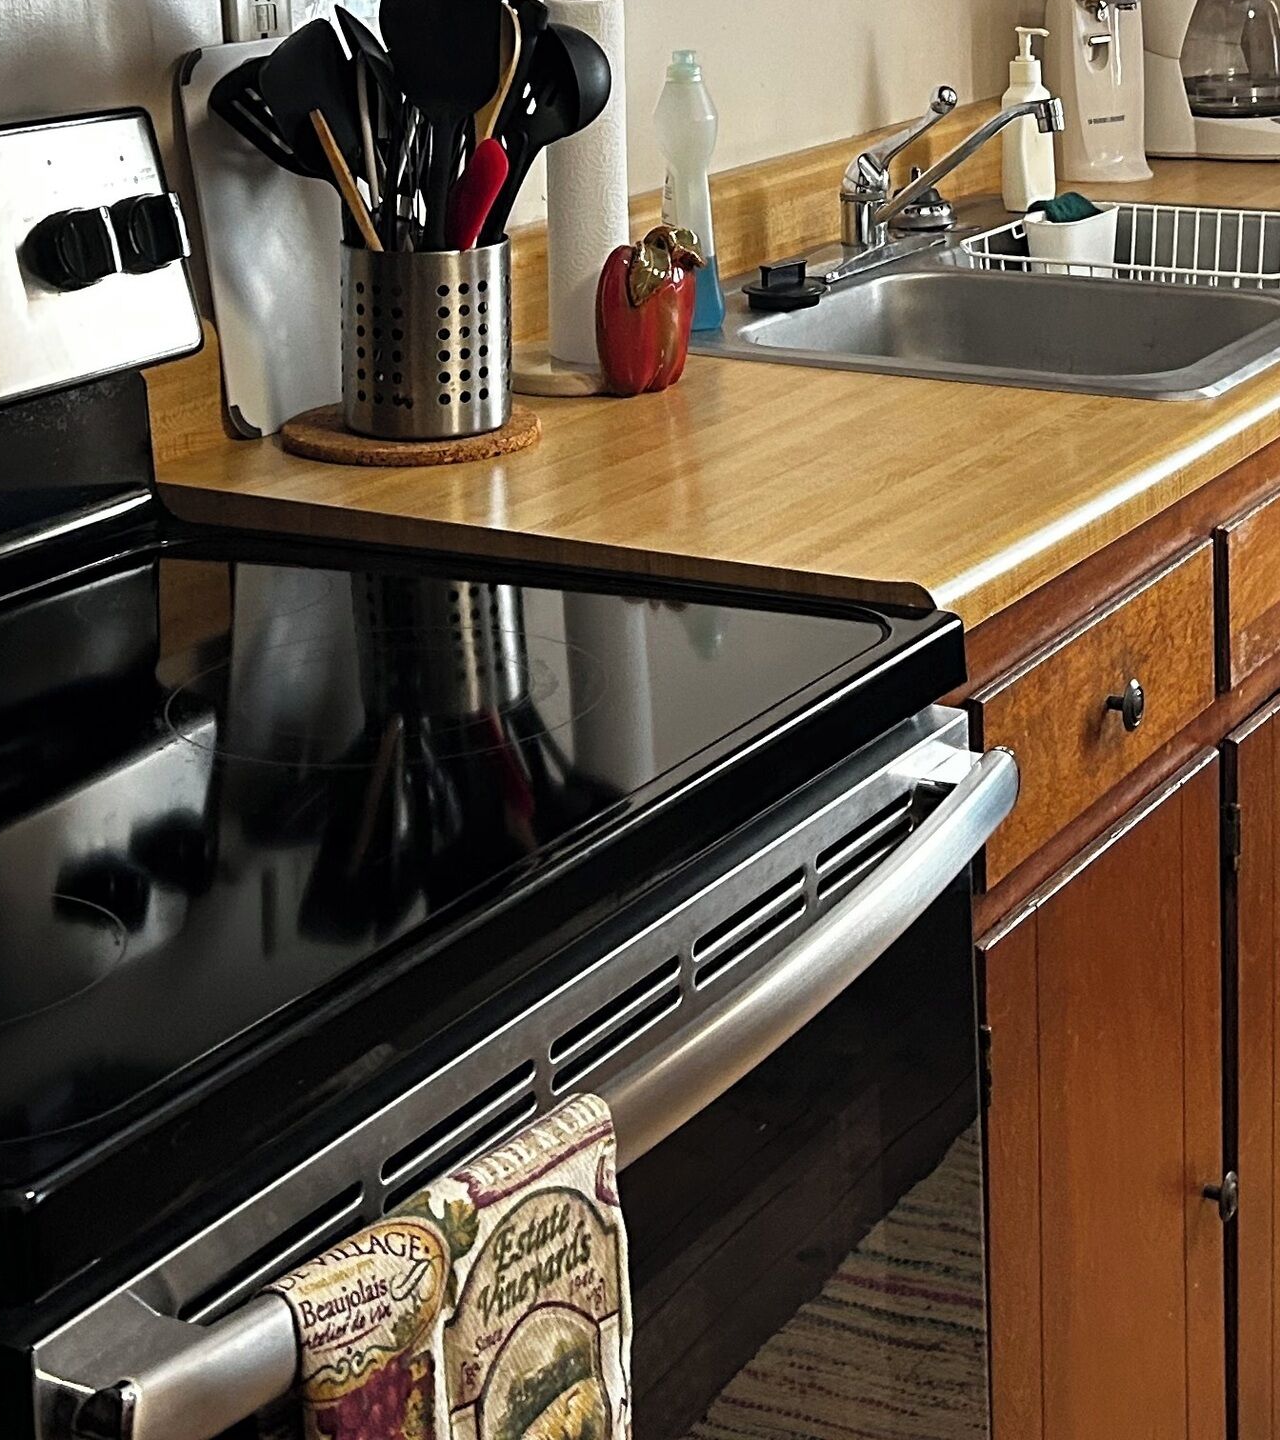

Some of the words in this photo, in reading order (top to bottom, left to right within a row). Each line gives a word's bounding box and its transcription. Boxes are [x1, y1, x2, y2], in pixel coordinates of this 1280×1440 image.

[495, 1203, 571, 1272] Estate
[298, 1274, 389, 1330] Beaujolais
[477, 1219, 592, 1327] Vineyards
